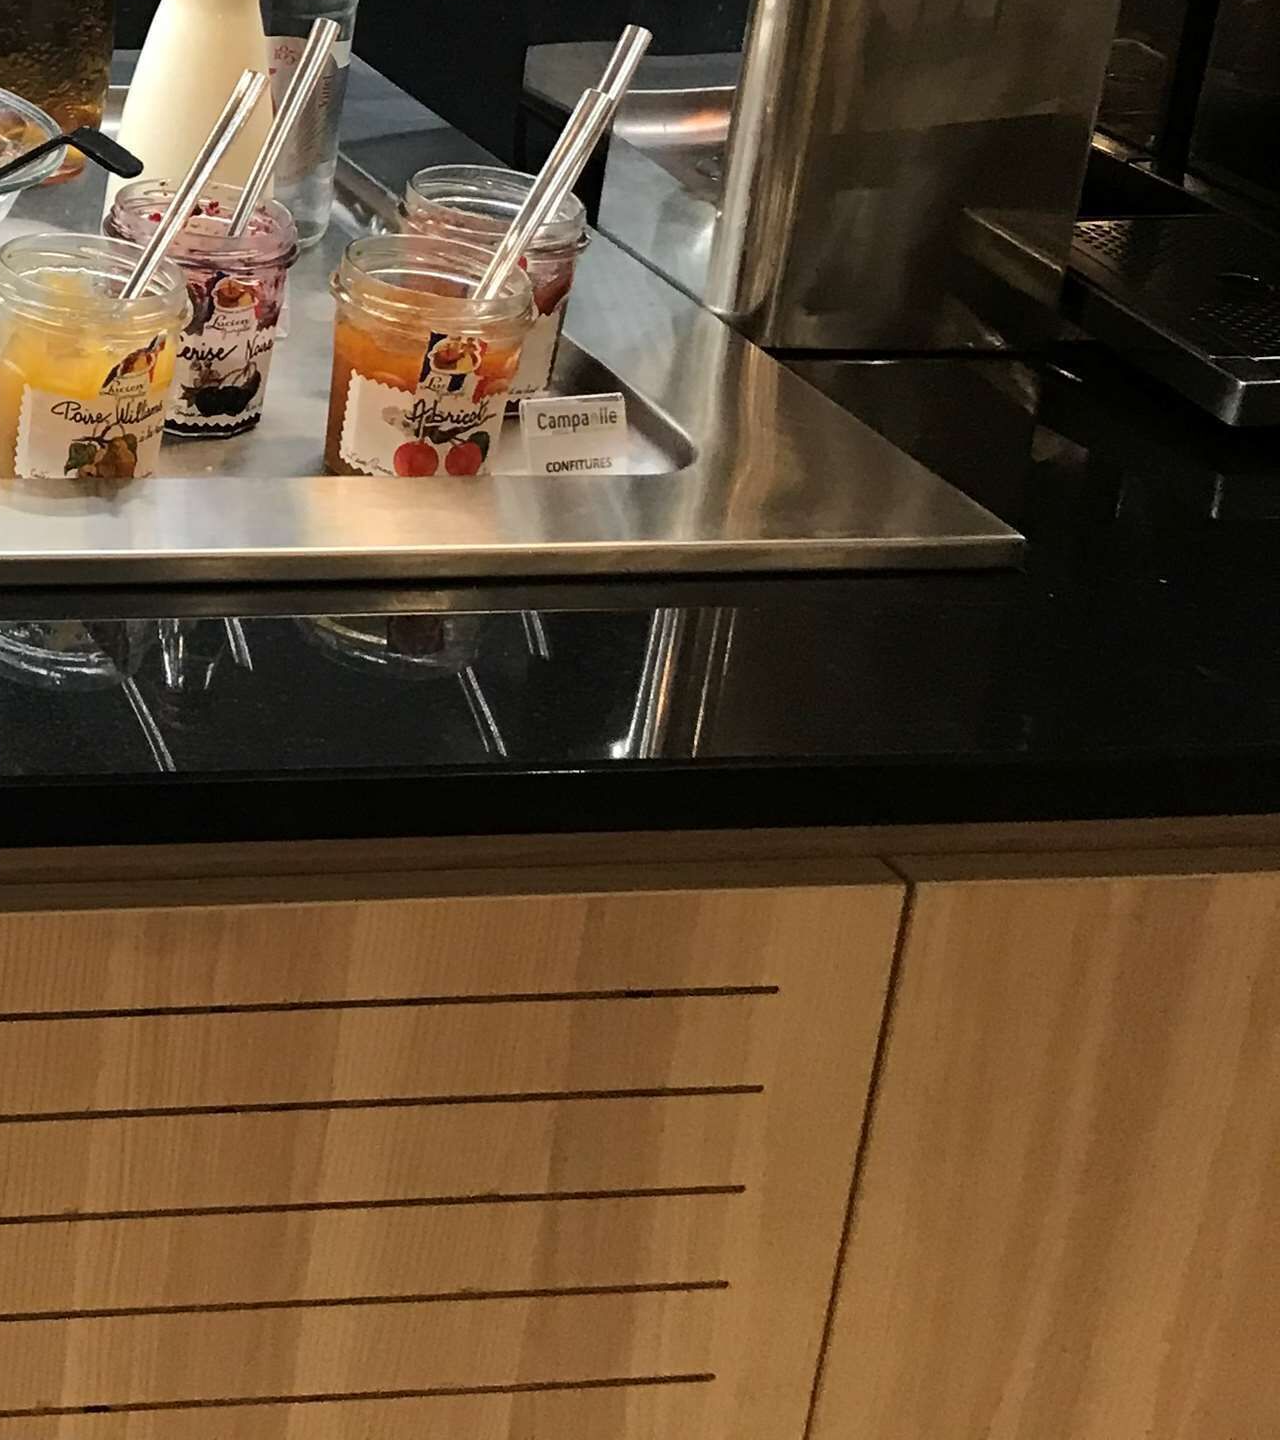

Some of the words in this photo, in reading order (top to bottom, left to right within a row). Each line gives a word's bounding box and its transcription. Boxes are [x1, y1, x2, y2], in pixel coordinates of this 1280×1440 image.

[176, 335, 239, 361] erise
[50, 400, 113, 425] Poire
[405, 398, 497, 428] Abricot
[545, 456, 614, 474] CONFITURES
